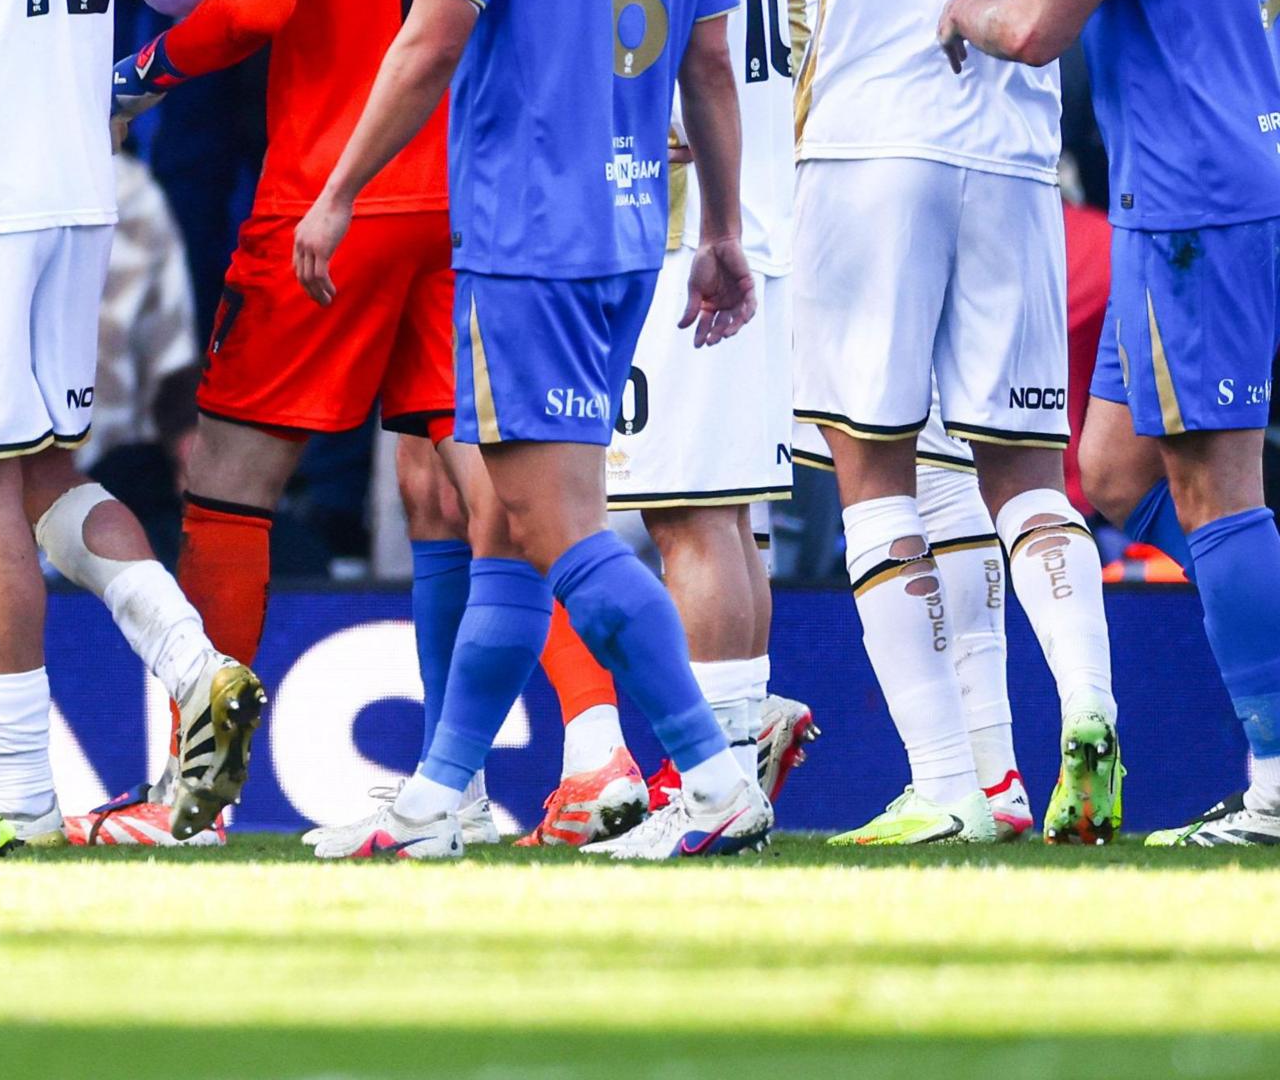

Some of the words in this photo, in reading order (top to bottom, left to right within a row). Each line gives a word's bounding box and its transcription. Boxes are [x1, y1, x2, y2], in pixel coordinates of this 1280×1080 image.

[613, 365, 649, 436] 0
[1009, 387, 1065, 410] NOCO
[1041, 549, 1073, 600] SUFC
[926, 593, 947, 652] SUFC
